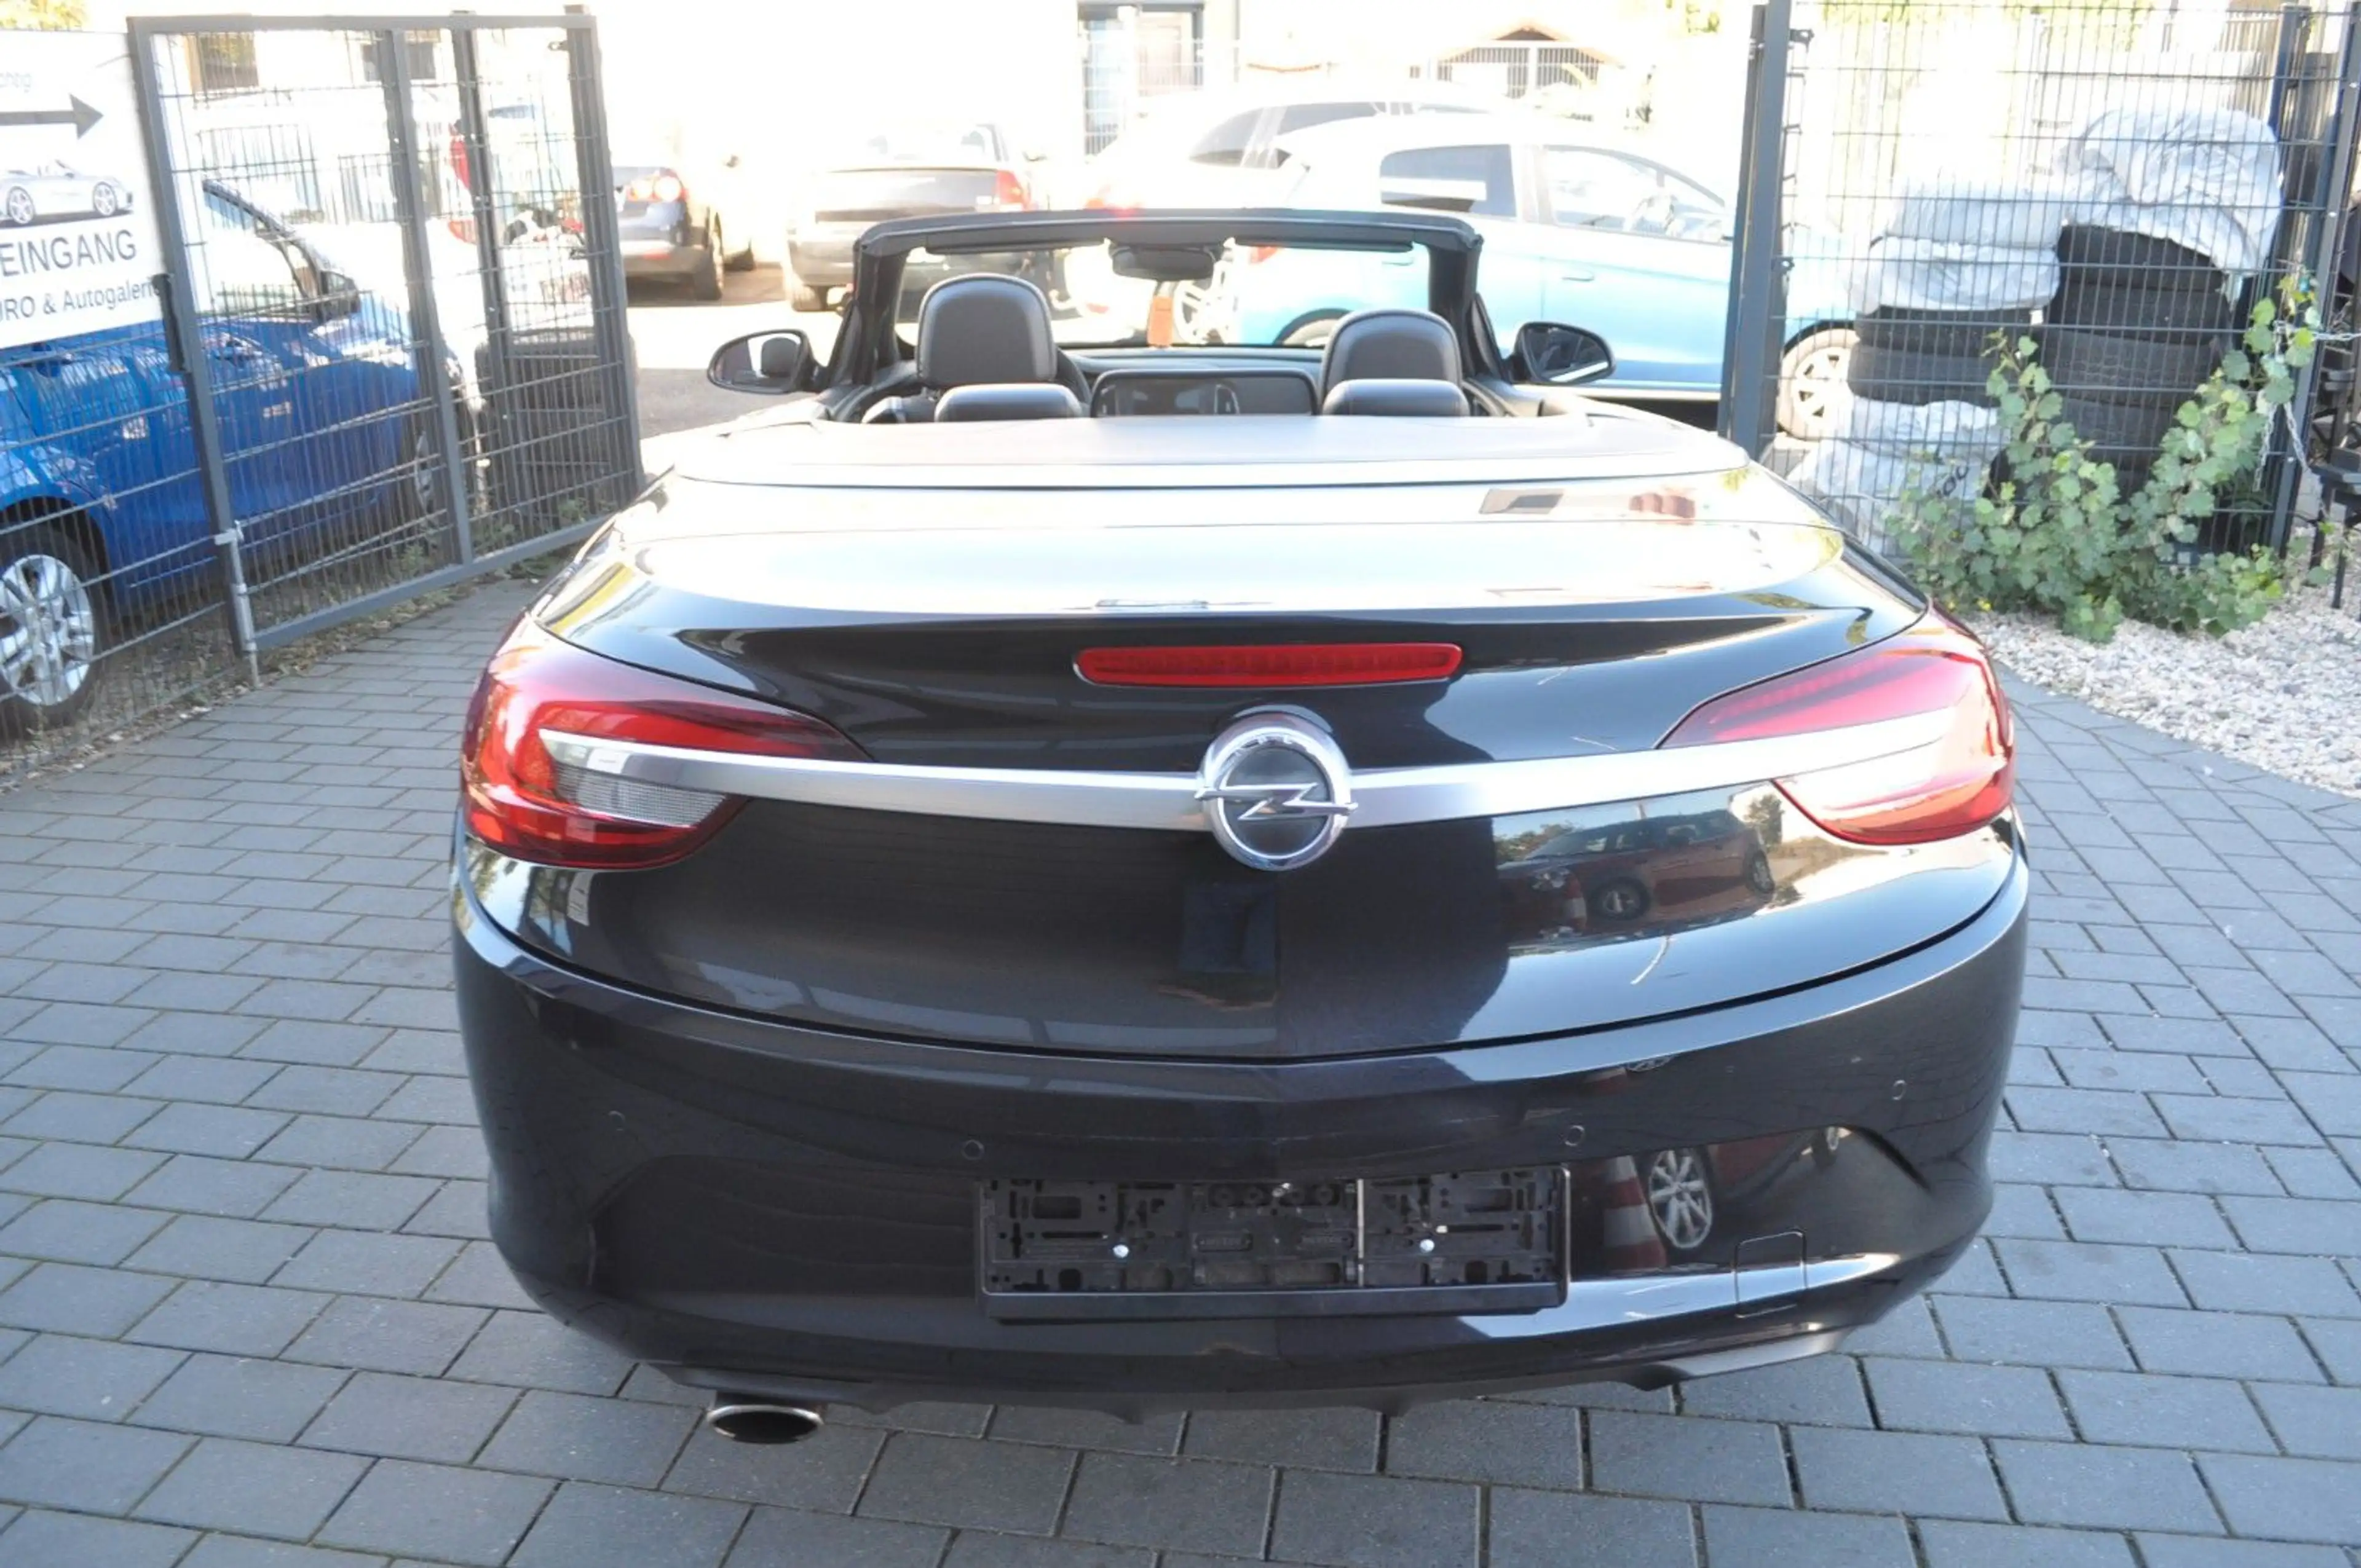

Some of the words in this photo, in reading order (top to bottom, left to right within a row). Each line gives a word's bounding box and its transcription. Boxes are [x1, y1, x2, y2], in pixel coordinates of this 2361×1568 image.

[0, 229, 136, 277] EINGANG
[0, 296, 35, 321] RO
[43, 293, 57, 315] &
[63, 278, 159, 311] Autogaleri
